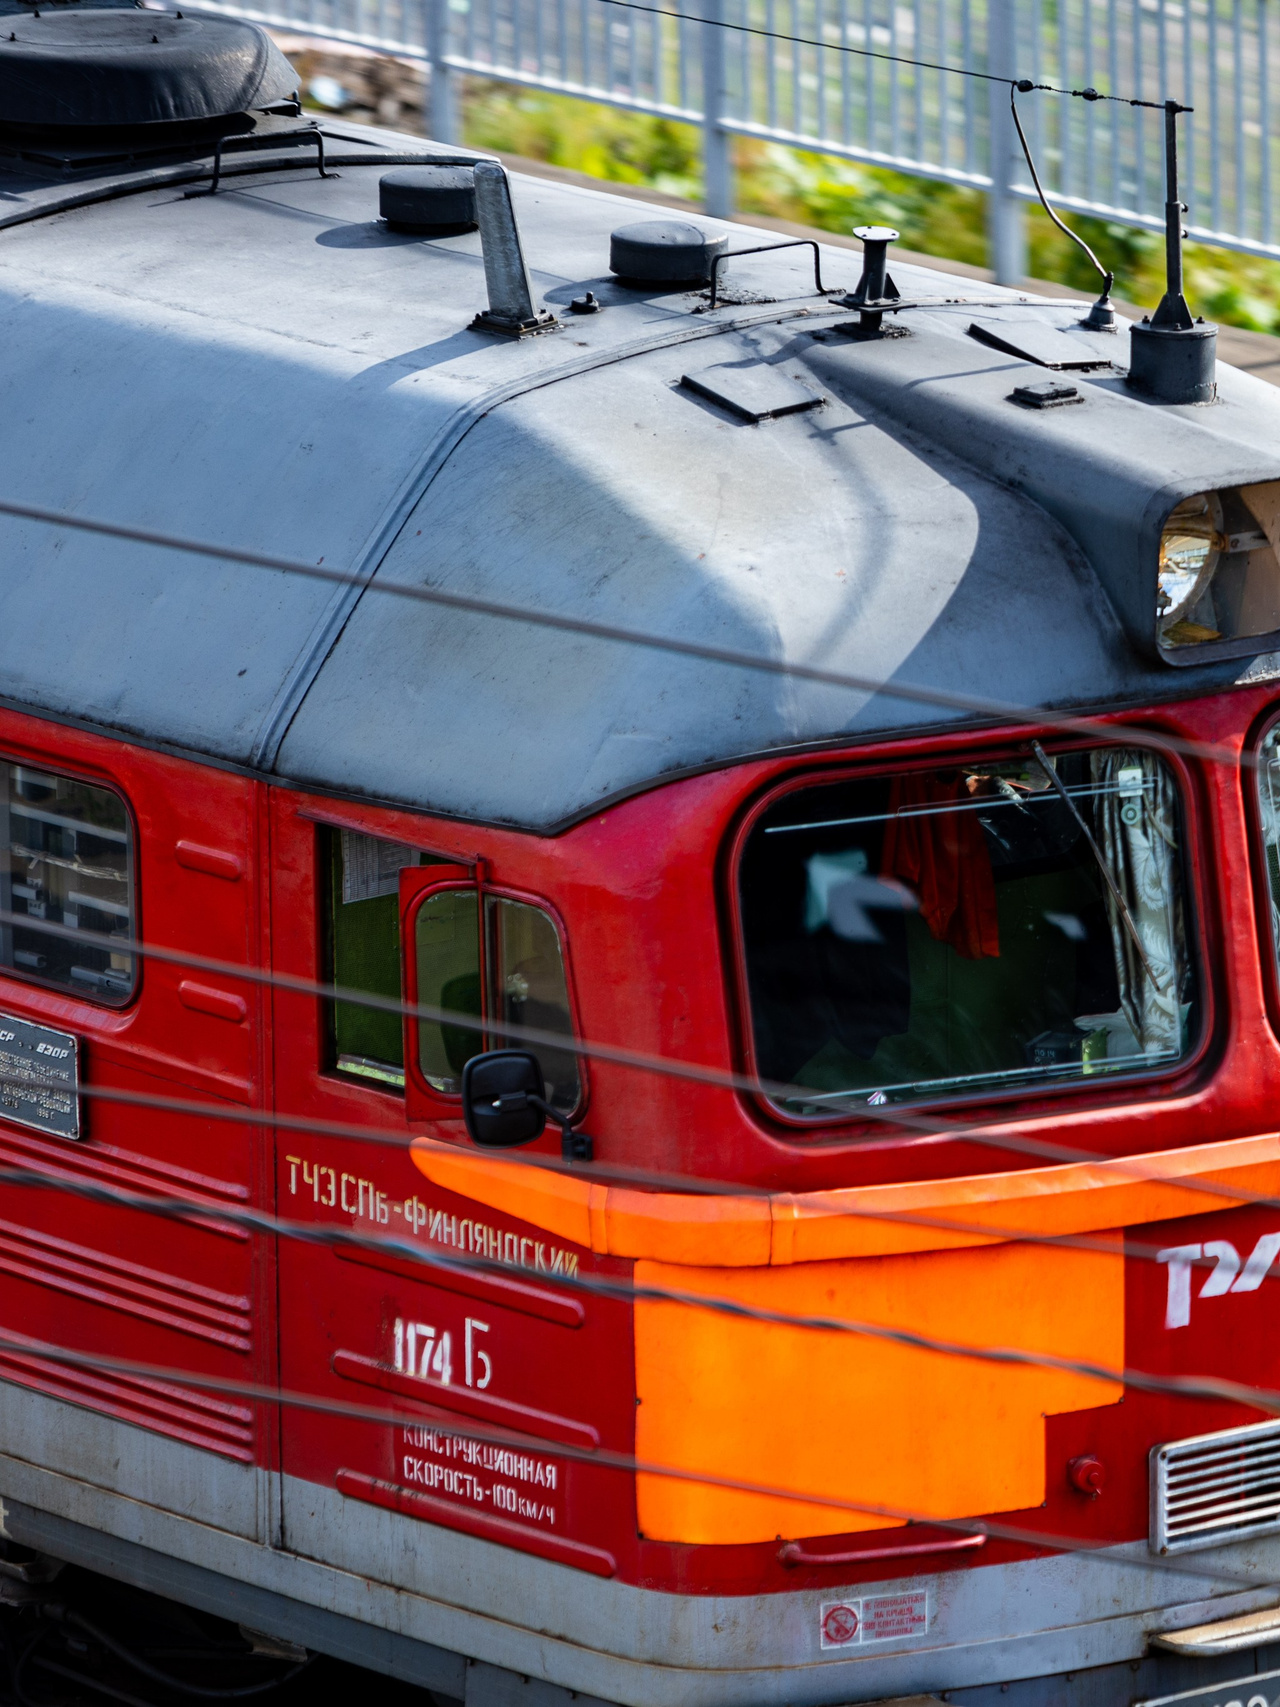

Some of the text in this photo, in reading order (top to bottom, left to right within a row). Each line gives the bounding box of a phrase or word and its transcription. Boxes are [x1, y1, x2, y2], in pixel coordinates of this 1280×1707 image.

[394, 1317, 490, 1389] 1174 Б
[404, 1422, 557, 1490] КОНСТРУКЦИОННАЯ
